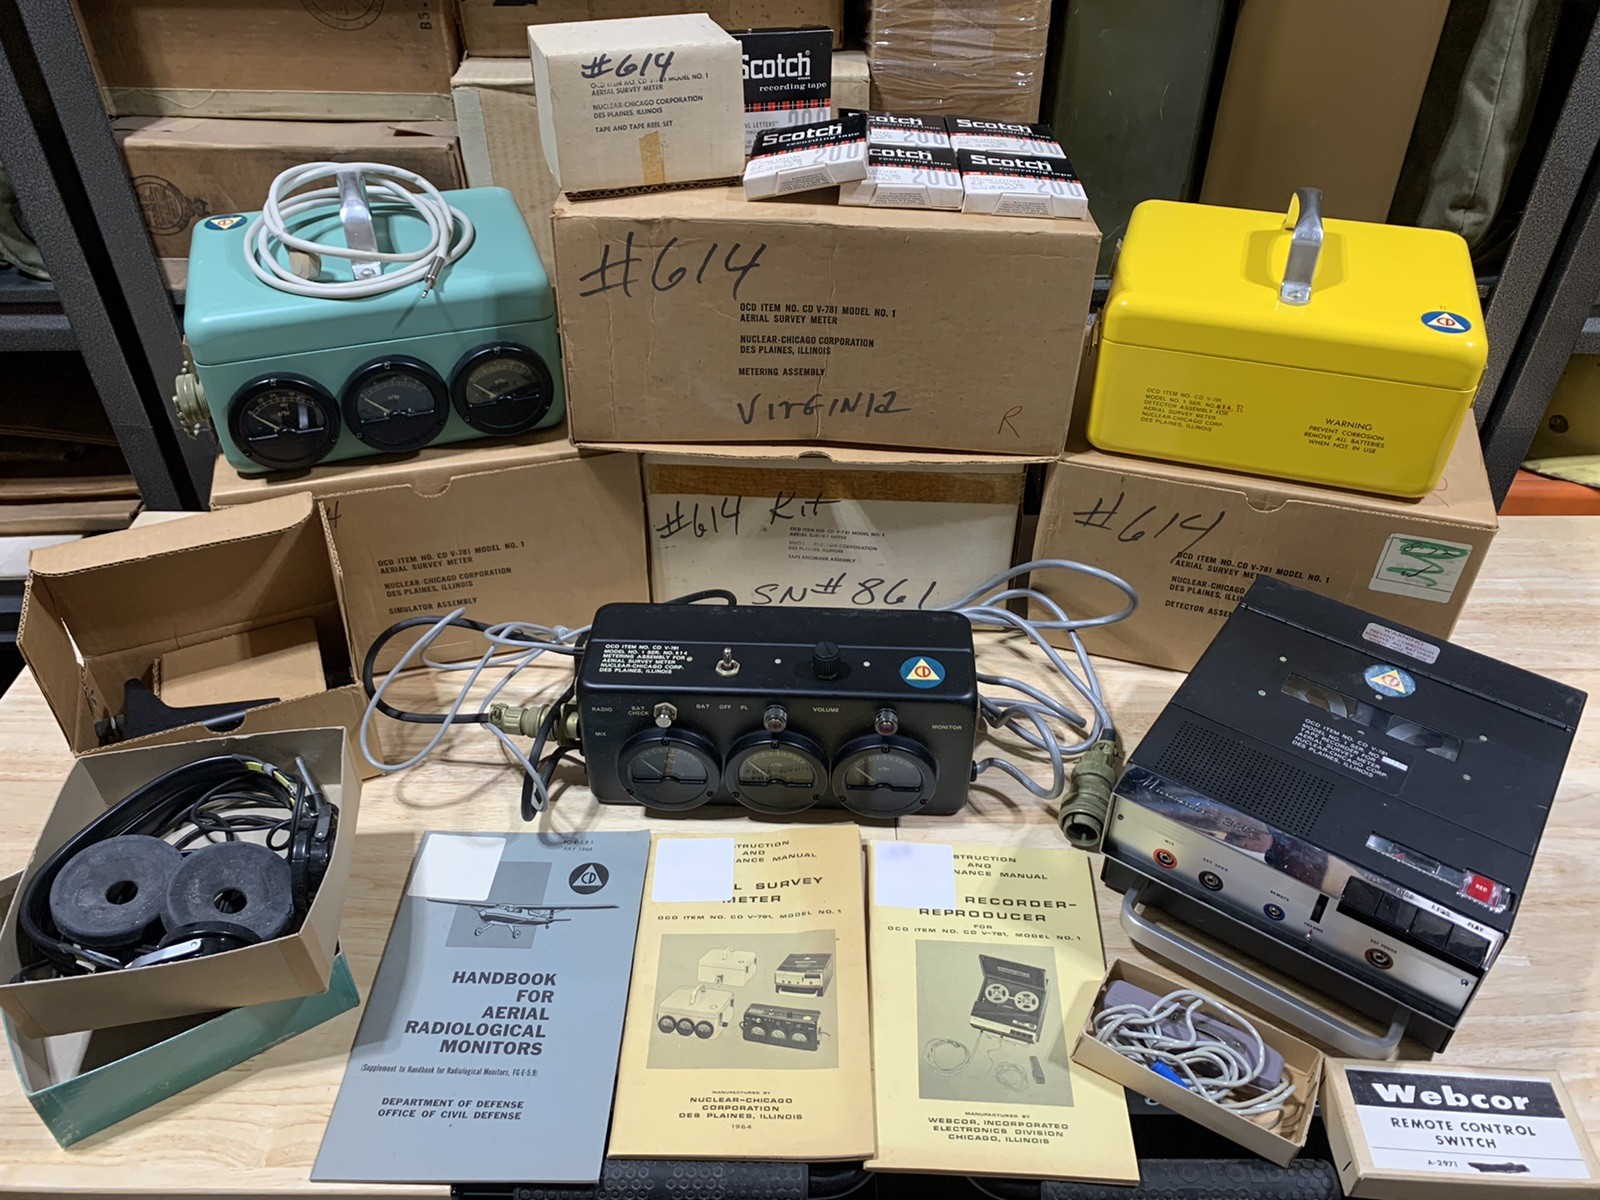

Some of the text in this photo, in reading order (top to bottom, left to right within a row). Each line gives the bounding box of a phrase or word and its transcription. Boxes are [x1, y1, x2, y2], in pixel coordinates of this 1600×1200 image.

[760, 83, 805, 91] recording
[957, 119, 1032, 133] Scotch
[762, 125, 842, 146] Scotch
[970, 155, 1052, 171] Scotch
[579, 232, 766, 300] #614
[739, 303, 756, 311] OCD
[760, 303, 780, 312] ITEM
[816, 305, 837, 314] V-781
[841, 306, 870, 316] MODEL
[874, 308, 888, 317] NO.
[739, 314, 837, 324] AERIAL SURVEY METER
[740, 334, 874, 347] NUCLEAR-CHICAGO CORPORATION
[740, 345, 830, 355] DES PLAINES, ILLINOIS
[738, 367, 825, 376] METERING ASSEMBLY
[1325, 418, 1372, 430] WARNING
[1304, 431, 1332, 440] REMOVE
[1350, 438, 1384, 448] BATTERIES
[1308, 425, 1384, 440] PREVENT CORROSION
[397, 556, 417, 564] ITEM
[449, 548, 470, 557] V-781
[474, 544, 500, 553] MODEL
[380, 556, 473, 574] AERIAL SURVEY METER
[1196, 554, 1216, 563] ITEM
[1220, 558, 1234, 566] NO.
[1251, 563, 1272, 573] V-781
[1275, 568, 1303, 579] MODEL
[1307, 573, 1321, 582] NO.
[384, 567, 511, 589] NUCLEAR-CHICAGO CORPORATION
[403, 585, 439, 595] PLAINES,
[441, 580, 473, 590] ILLINOIS
[388, 597, 476, 614] SIMULATOR ASSEMBLY
[914, 665, 931, 677] CD
[772, 852, 817, 862] MANUAL
[581, 873, 597, 884] CD
[756, 876, 823, 890] SURVEY
[965, 896, 1077, 909] RECORDER-
[919, 908, 1046, 922] REPRODUCER
[1467, 922, 1484, 932] PLAY
[452, 971, 556, 986] HANDBOOK
[516, 990, 554, 1003] FOR
[482, 1006, 550, 1020] AERIAL
[404, 1020, 546, 1038] RADIOLOGICAL
[439, 1040, 542, 1055] MONITORS
[447, 1067, 482, 1076] Radiological
[381, 1097, 454, 1106] DEPARTMENT
[476, 1100, 523, 1108] DEFENSE
[1371, 1083, 1529, 1110] Webcor
[377, 1109, 416, 1117] OFFICE
[473, 1111, 521, 1119] DEFENSE
[928, 1117, 1068, 1129] WEBCOR, INCORPORATED
[1391, 1118, 1536, 1136] REMOTE CONTROL
[933, 1125, 1063, 1137] ELECTRONICS DIVISION
[948, 1133, 1000, 1142] CHICAGO,
[1436, 1135, 1496, 1149] SWITCH
